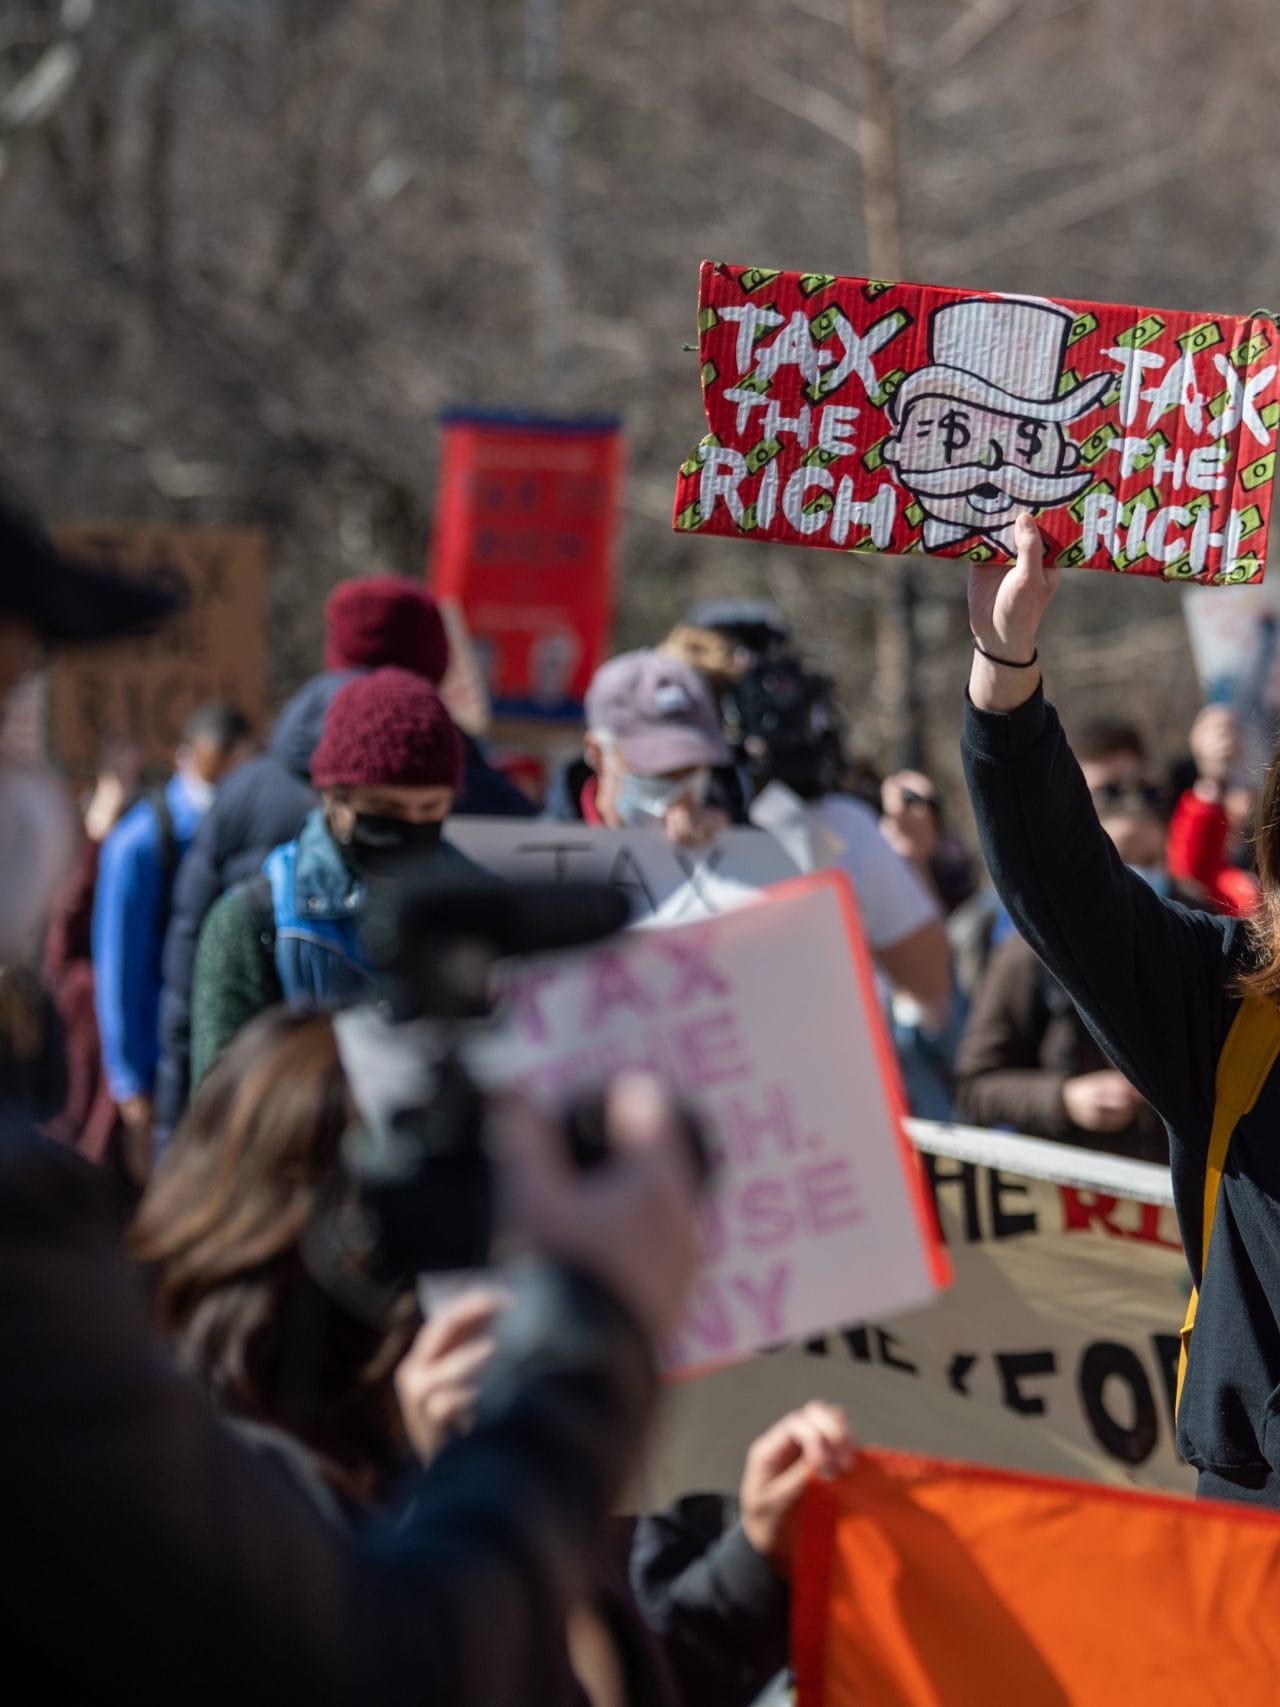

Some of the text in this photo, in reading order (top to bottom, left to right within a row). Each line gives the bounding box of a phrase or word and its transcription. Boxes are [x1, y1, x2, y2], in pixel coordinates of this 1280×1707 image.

[717, 302, 899, 397] TAX
[1101, 347, 1278, 446] TAX
[723, 388, 861, 456] THE
[1108, 437, 1228, 490] THE
[698, 444, 897, 548] RICH
[1081, 492, 1241, 574] RICH
[492, 930, 734, 1046] TAX
[919, 1151, 1038, 1244] HE
